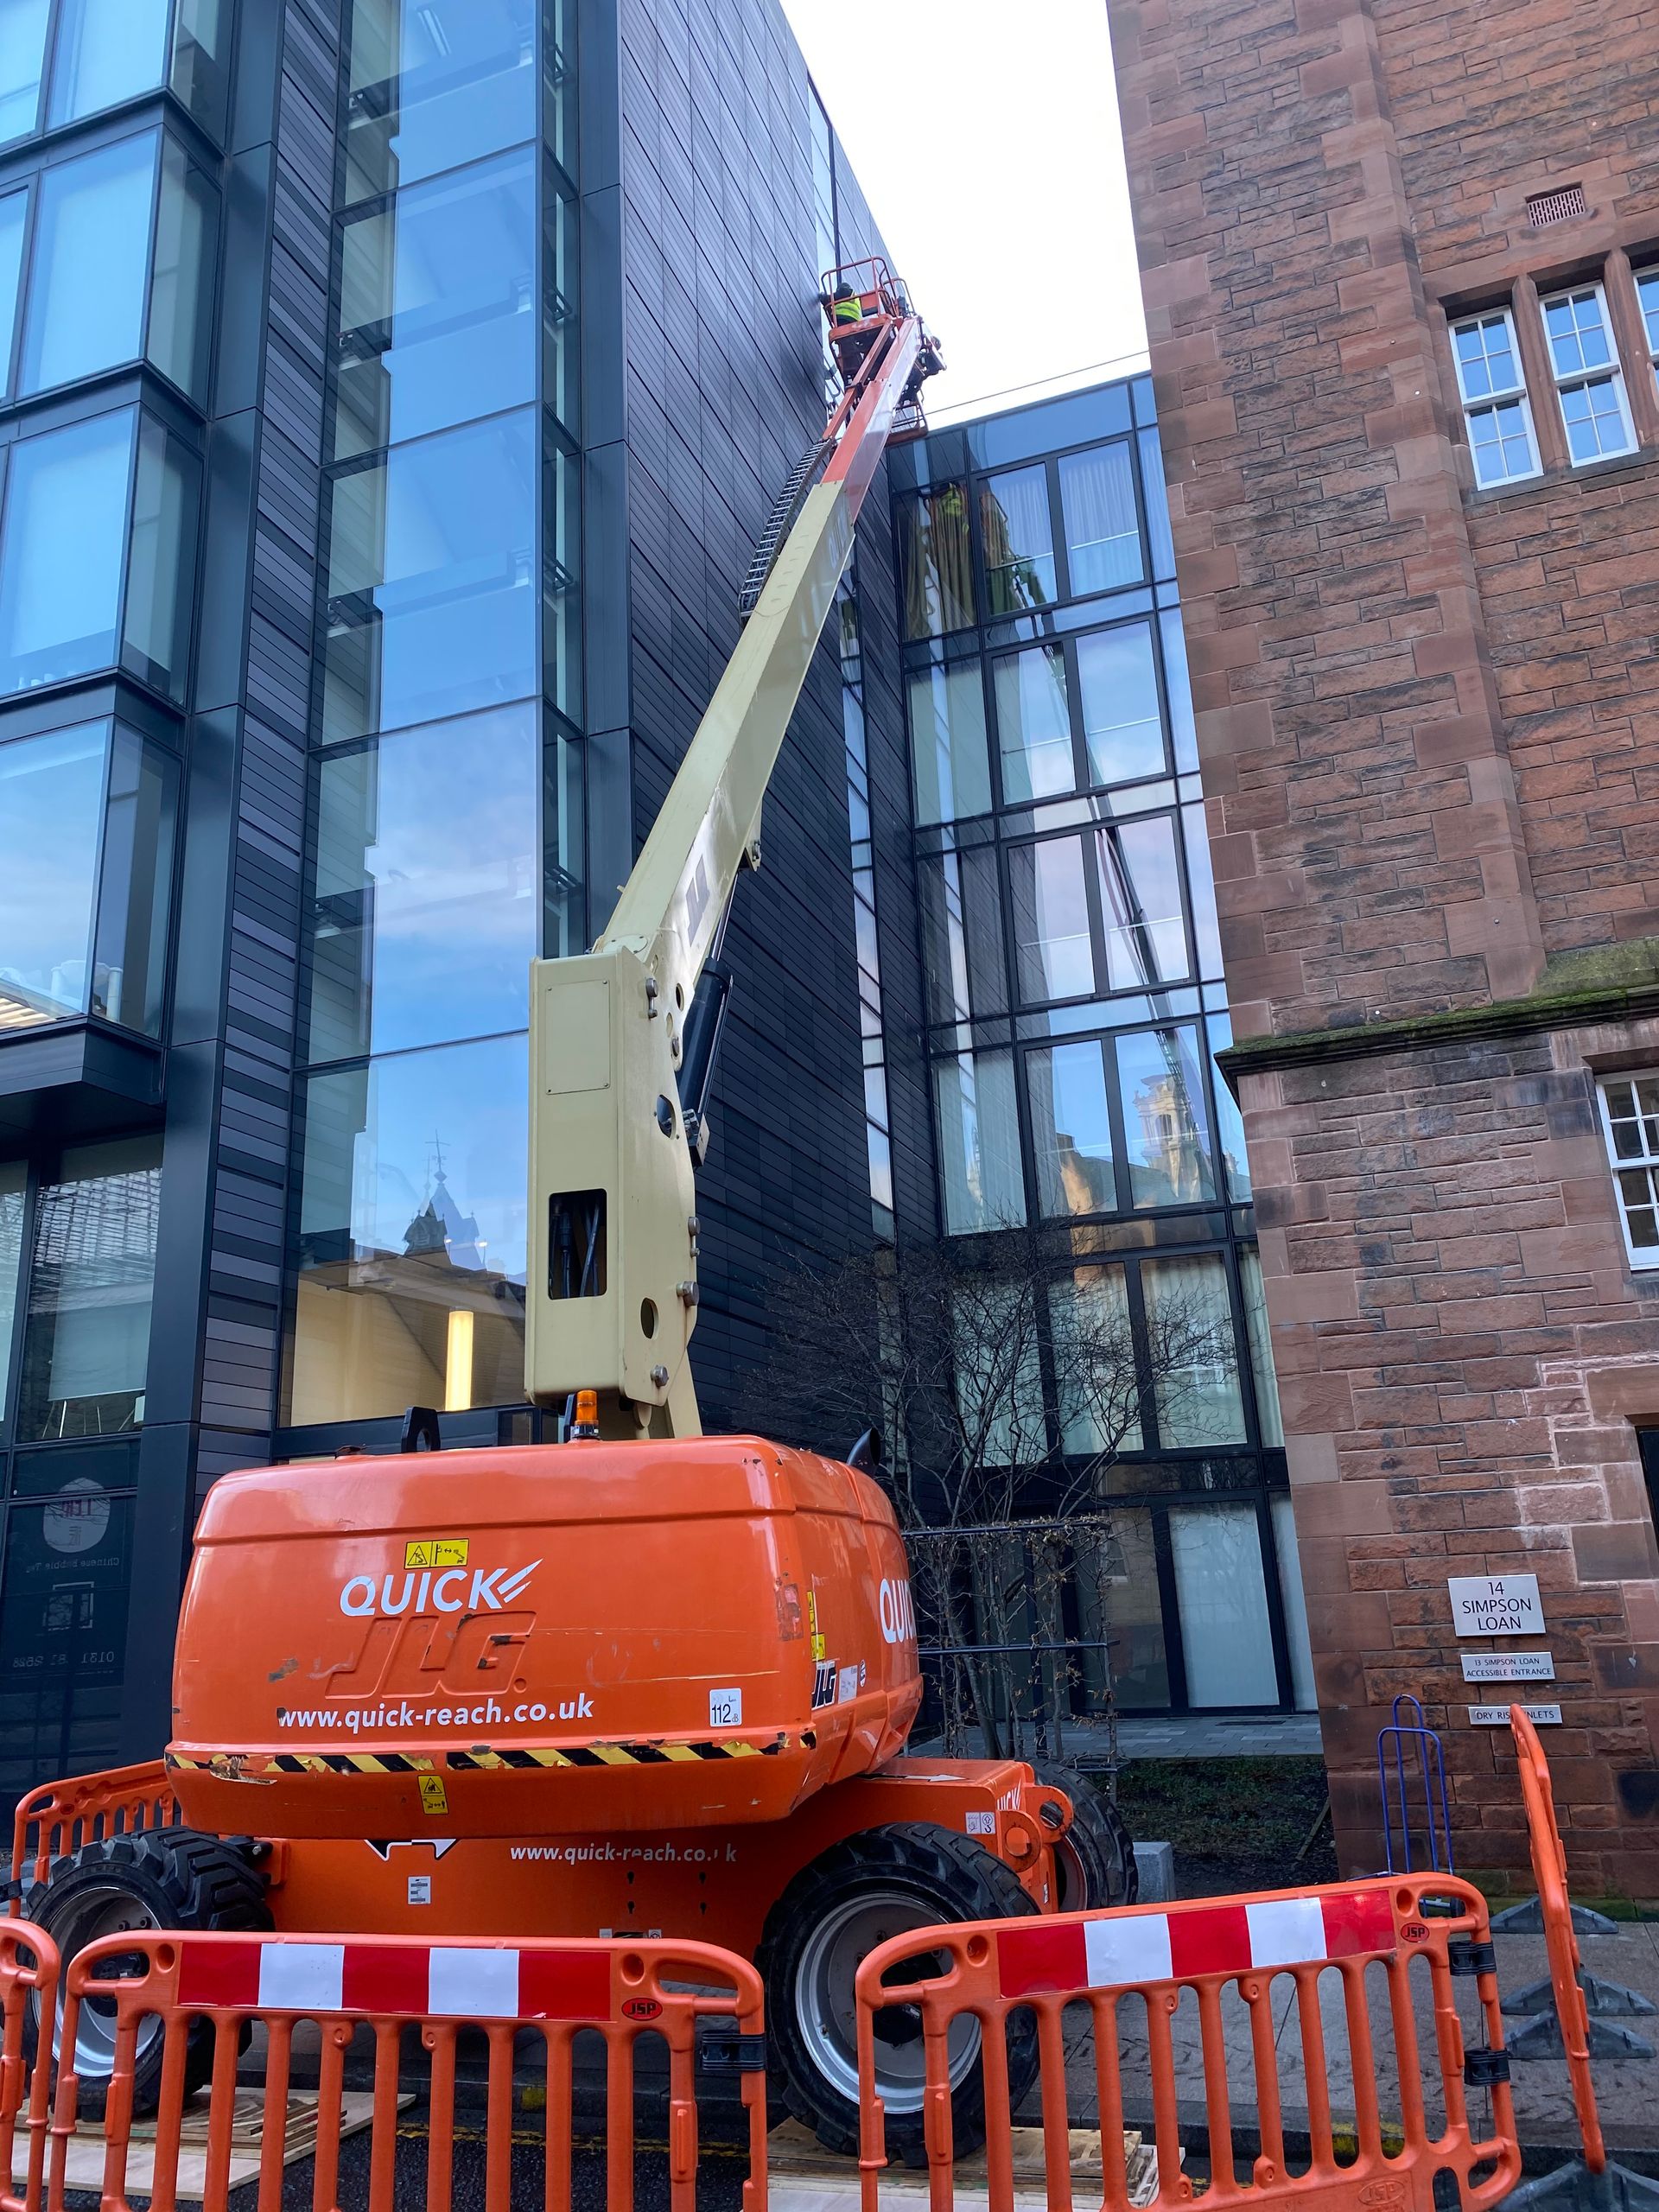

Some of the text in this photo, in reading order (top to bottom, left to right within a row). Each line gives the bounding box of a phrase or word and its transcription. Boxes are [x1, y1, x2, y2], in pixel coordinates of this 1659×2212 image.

[340, 1568, 508, 1617] QUICK
[1488, 1581, 1504, 1595] 14
[880, 1578, 917, 1643] QUIC
[1462, 1598, 1532, 1614] SIMPSON
[1478, 1616, 1522, 1630] LOAN
[277, 1694, 594, 1734] www.quick-reach.co.uk
[711, 1703, 731, 1724] 112
[511, 1842, 737, 1866] www.quick-reach.co.k
[1405, 1927, 1426, 1937] JSP
[628, 2002, 657, 2015] JSP
